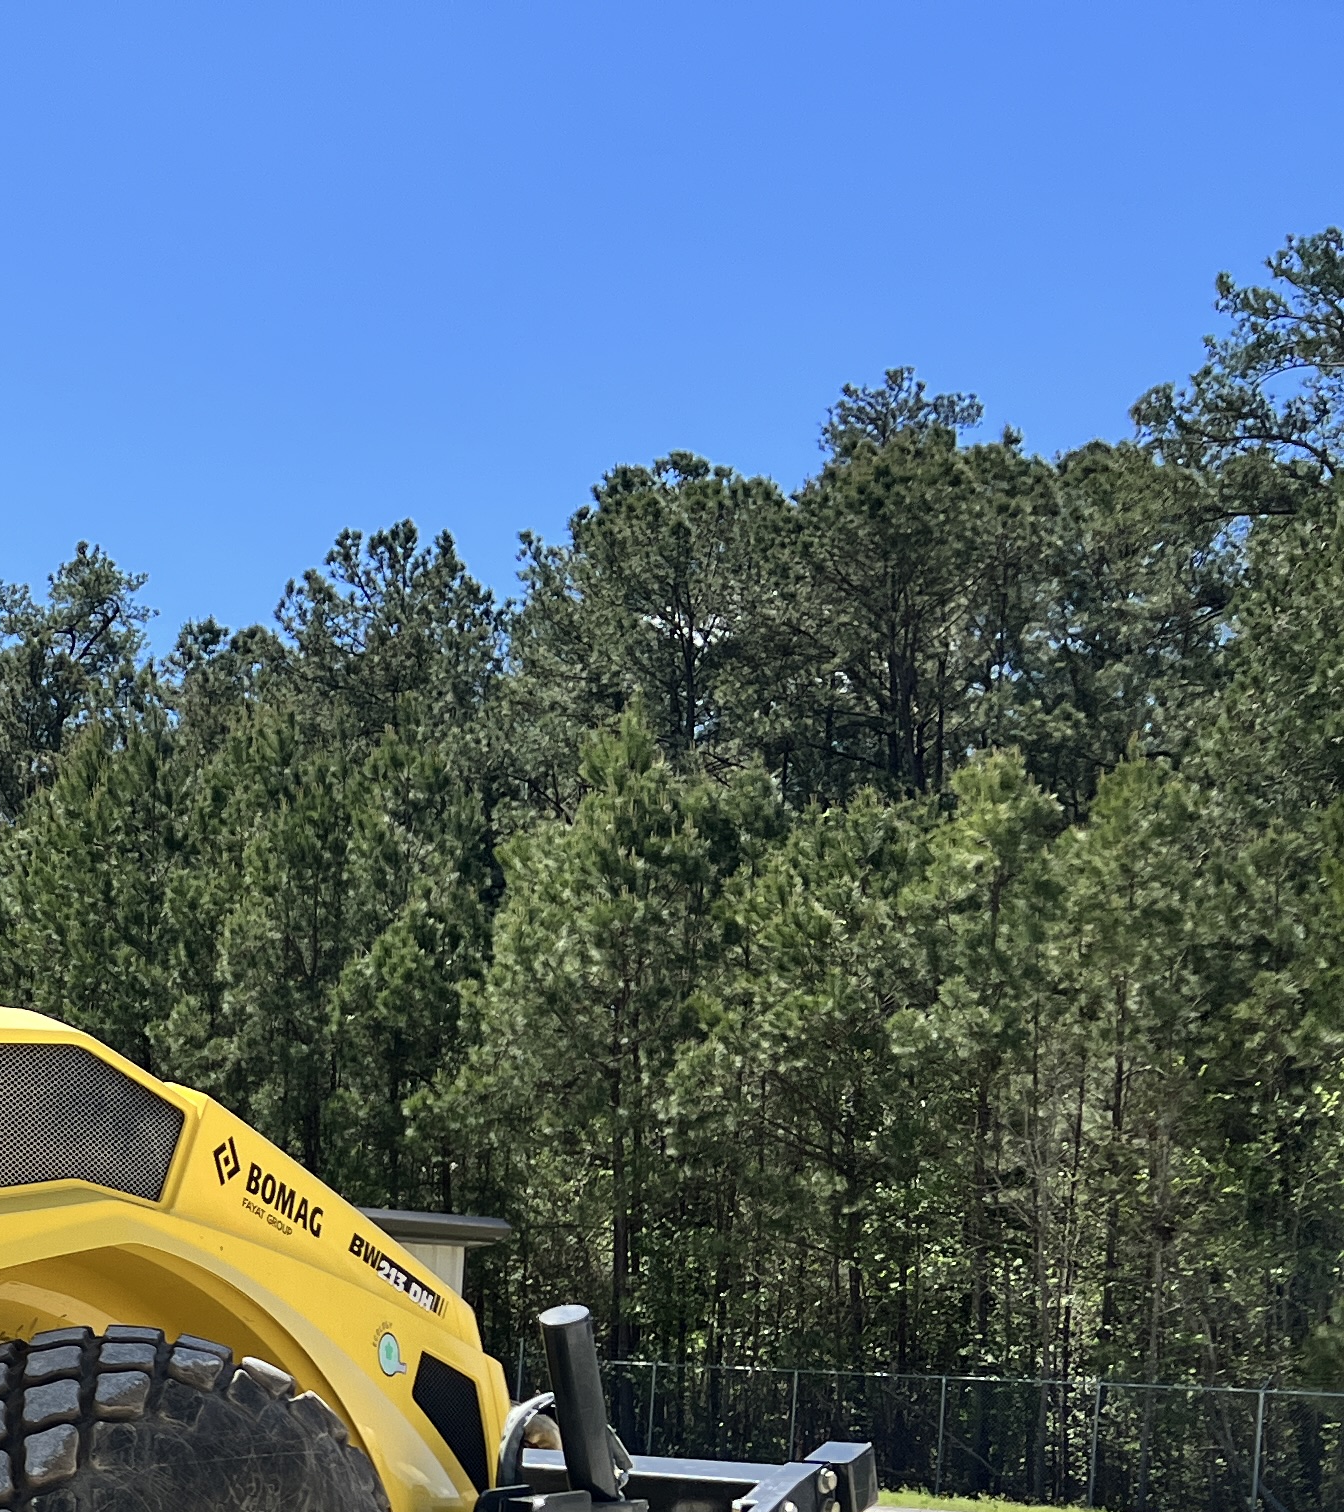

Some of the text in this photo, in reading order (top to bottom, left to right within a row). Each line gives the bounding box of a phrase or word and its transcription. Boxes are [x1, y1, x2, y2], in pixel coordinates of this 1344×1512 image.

[241, 1197, 293, 1236] FAYAT GROUP
[245, 1161, 324, 1239] BOMAG
